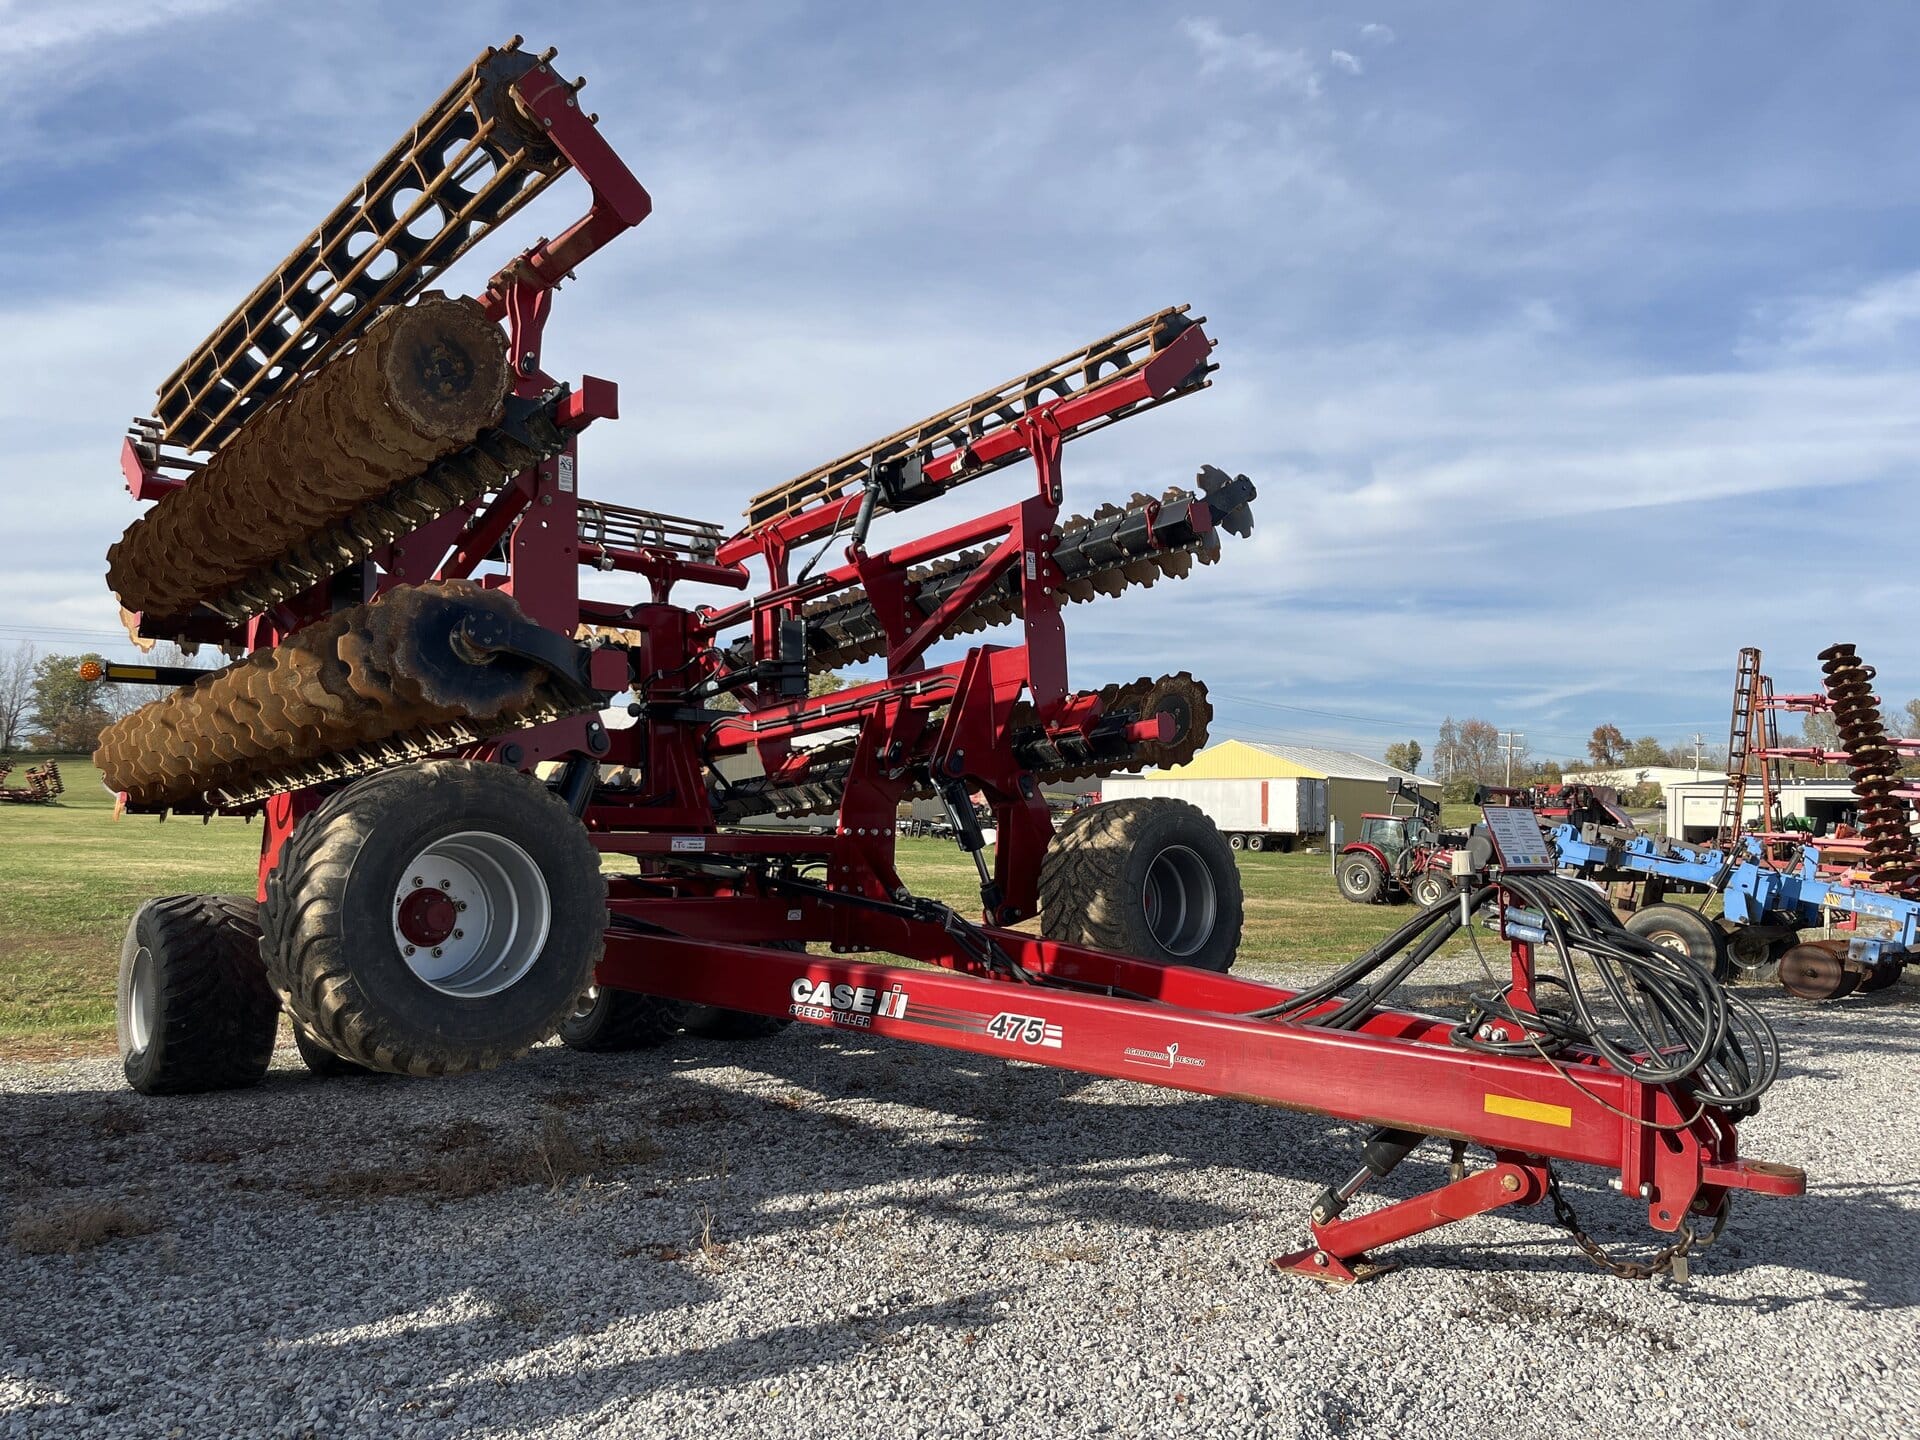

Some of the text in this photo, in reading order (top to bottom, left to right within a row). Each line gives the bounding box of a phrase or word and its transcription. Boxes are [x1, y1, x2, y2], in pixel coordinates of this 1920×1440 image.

[790, 978, 876, 1013] CASE
[789, 1003, 871, 1028] SPEED-TILLER
[986, 1012, 1045, 1045] 475
[1123, 1047, 1206, 1067] AGRONOMIC DESIGN
